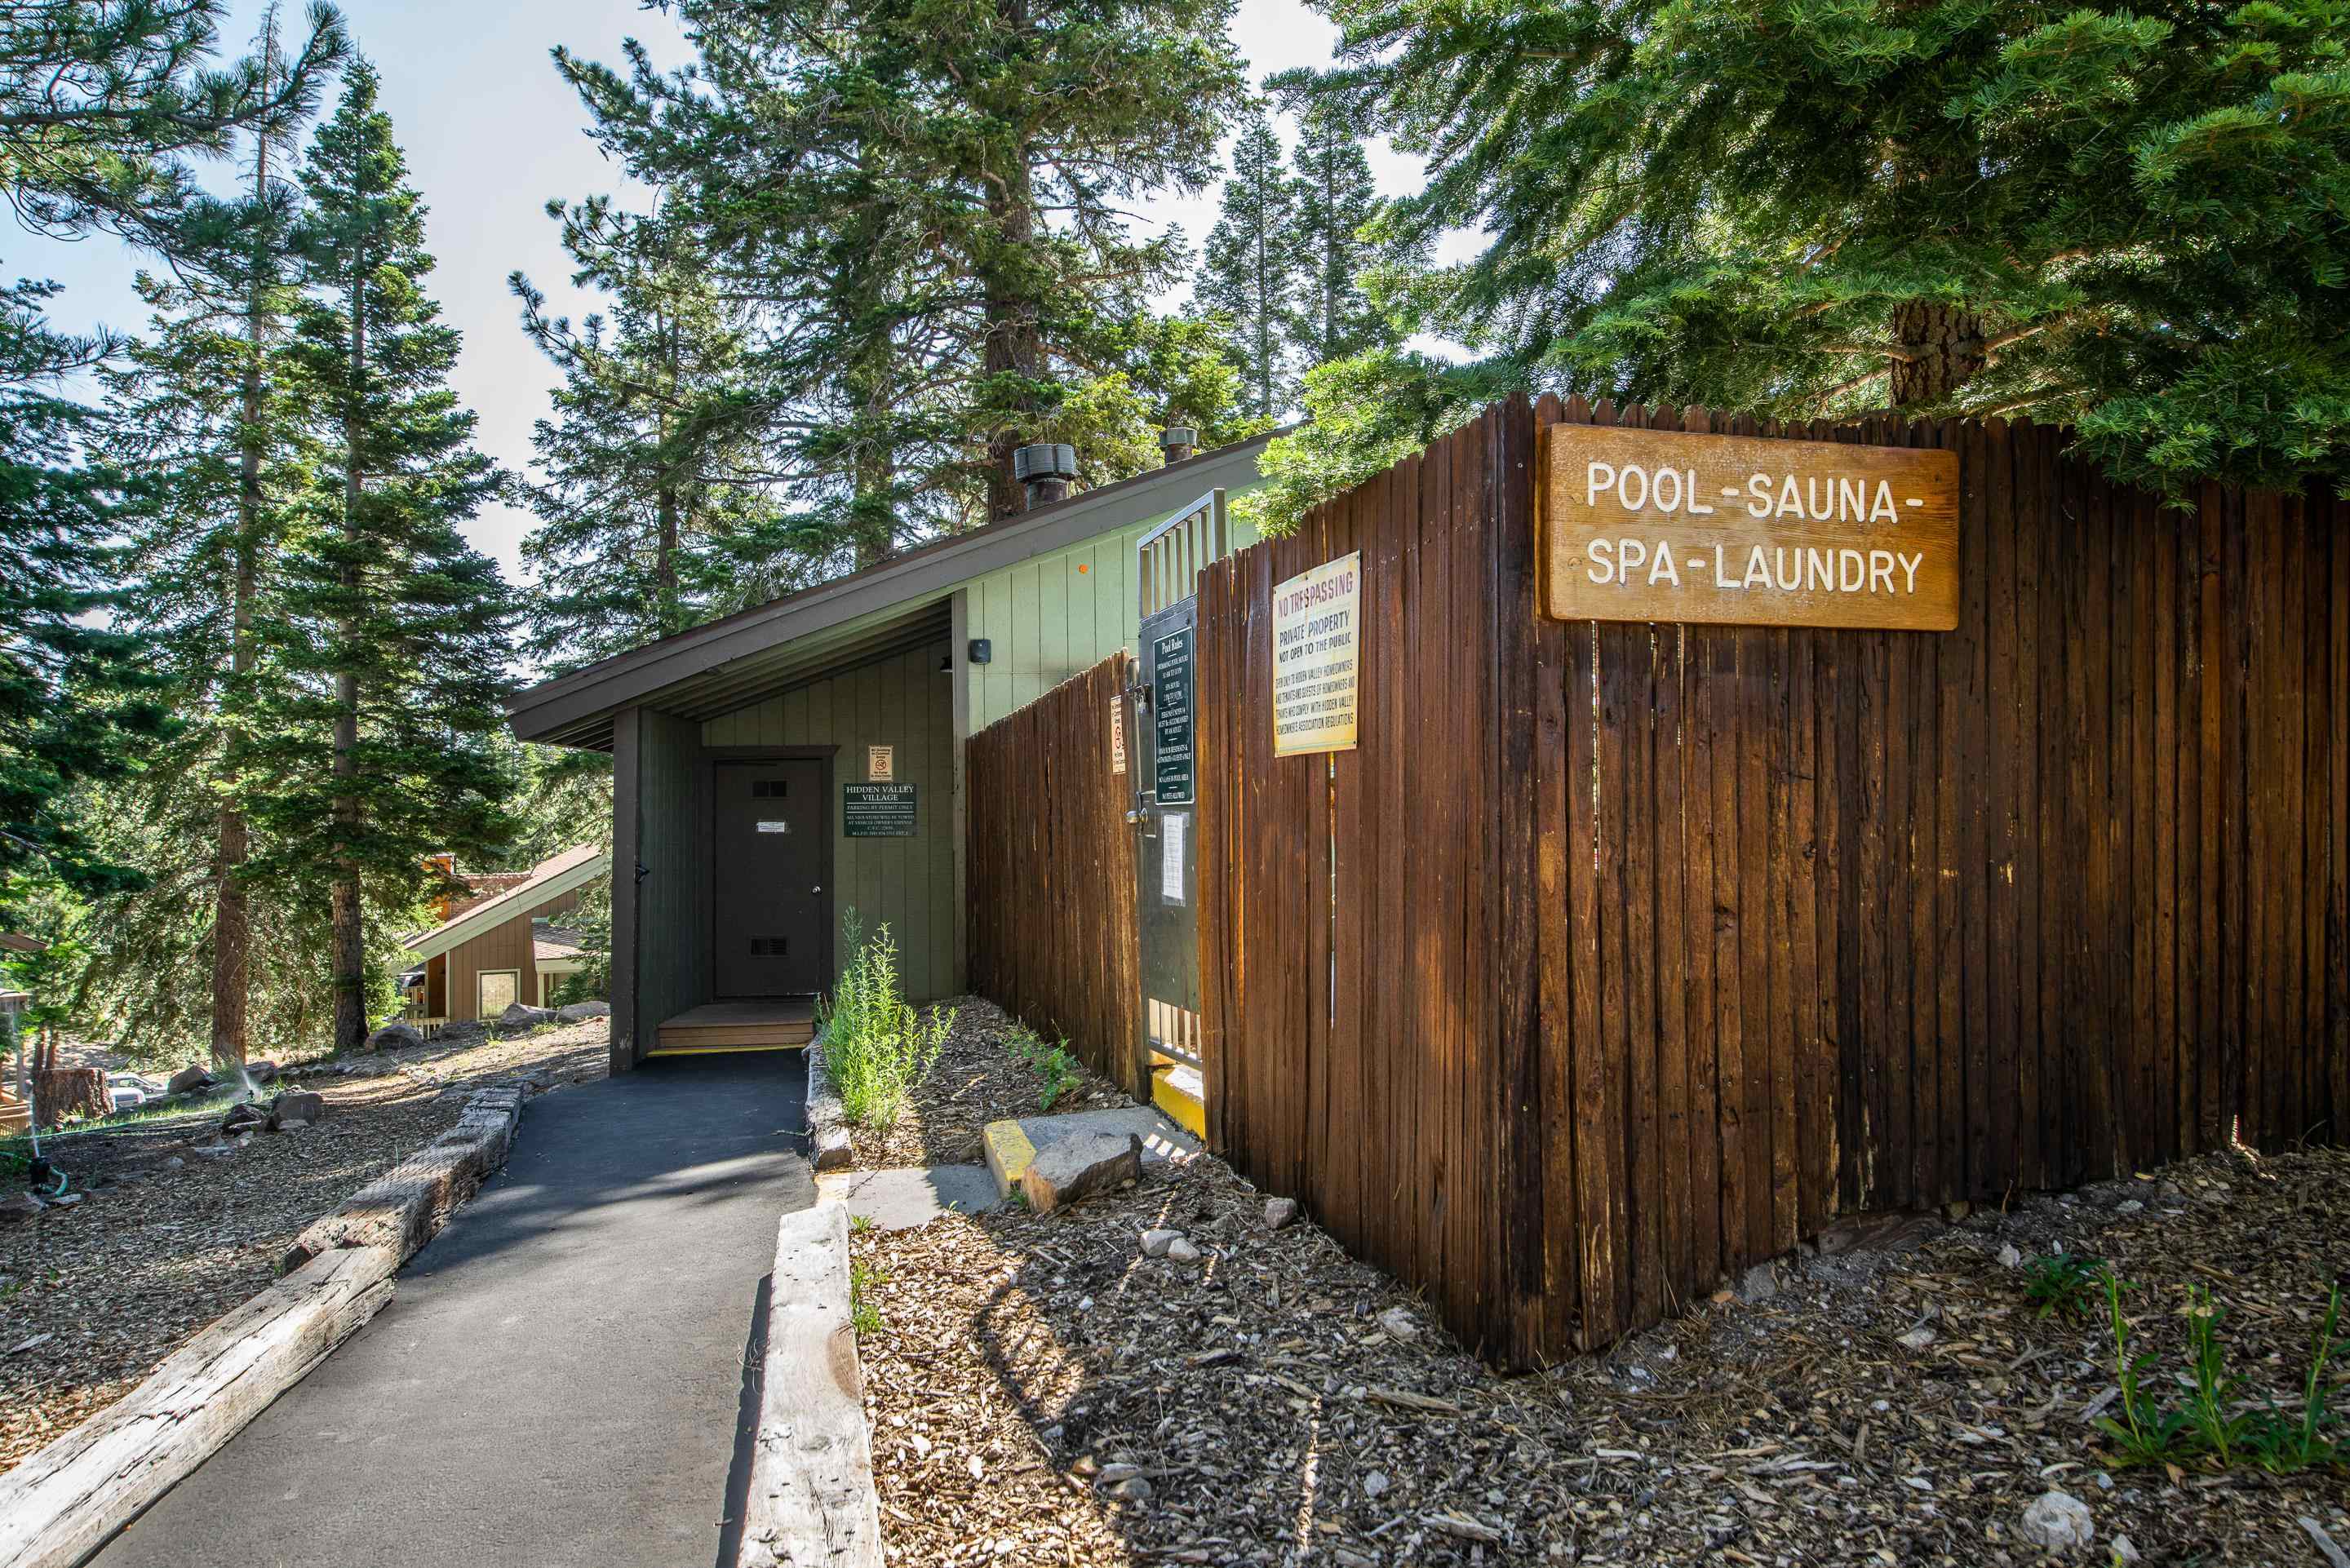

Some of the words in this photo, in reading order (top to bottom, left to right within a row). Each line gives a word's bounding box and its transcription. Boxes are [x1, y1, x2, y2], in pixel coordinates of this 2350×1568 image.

[1278, 599, 1288, 618] NO
[1290, 571, 1353, 613] TRESPASSING
[1279, 624, 1305, 647] PRIVATE
[1308, 609, 1350, 637] PROPERTY
[1162, 639, 1171, 654] Pool
[1172, 636, 1183, 651] Rules
[1279, 650, 1288, 663] NOT
[1290, 645, 1303, 660] OPEN
[1306, 642, 1314, 655] TO
[1316, 638, 1327, 653] THE
[1329, 631, 1351, 649] PUBLIC
[1308, 665, 1322, 680] VALLEY
